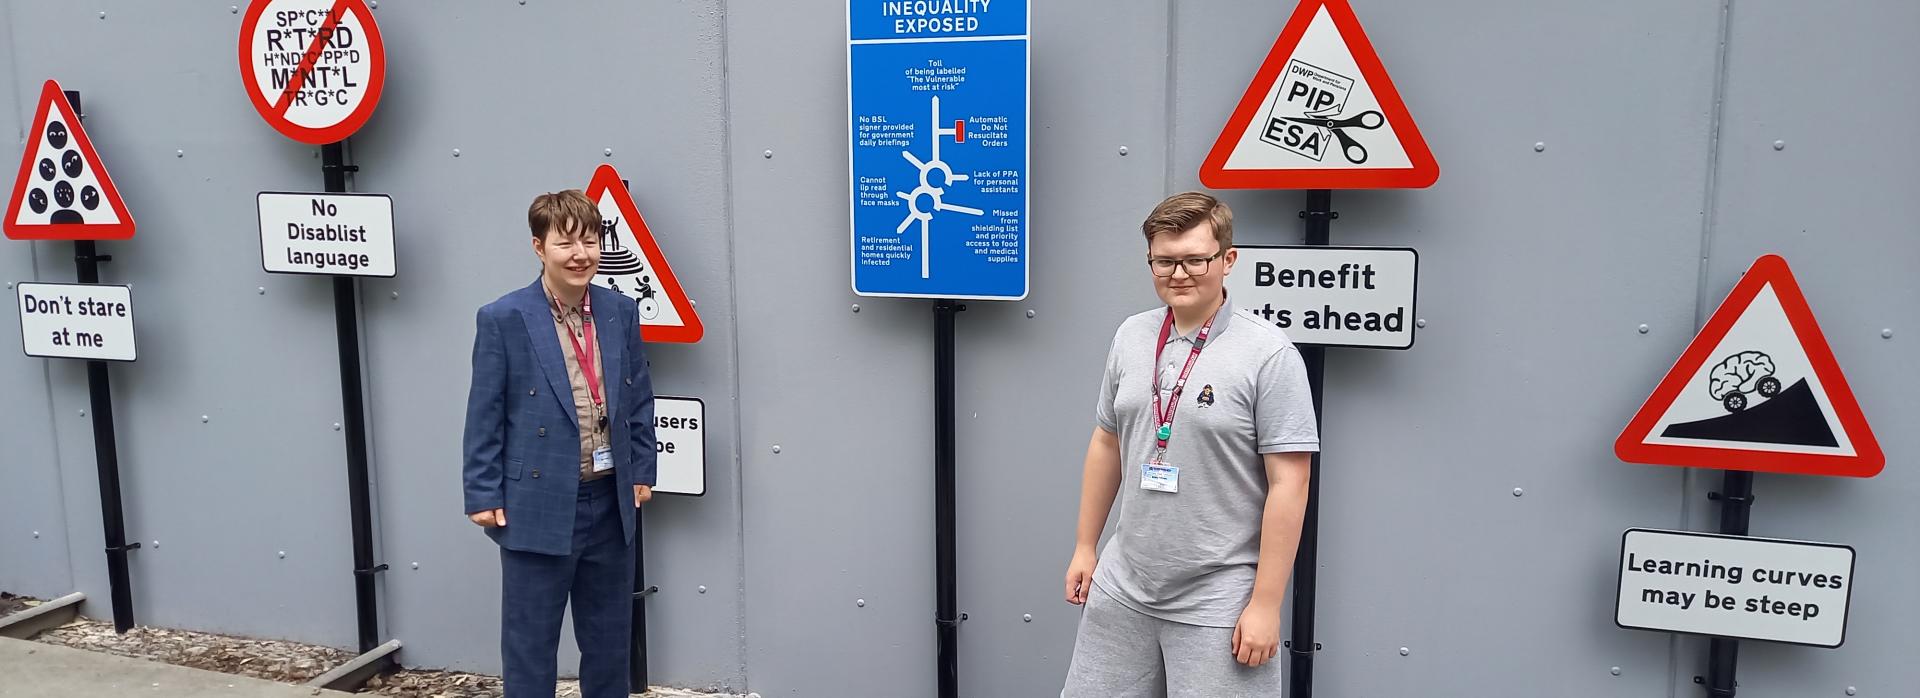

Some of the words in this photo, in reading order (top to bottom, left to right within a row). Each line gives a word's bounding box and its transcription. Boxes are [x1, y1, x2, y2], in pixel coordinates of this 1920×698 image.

[883, 0, 990, 16] INEQUALITY
[895, 17, 979, 34] EXPOSED
[928, 59, 942, 67] Toll
[914, 68, 935, 76] being
[936, 67, 966, 75] labelled
[1292, 65, 1314, 77] DWP
[925, 75, 965, 83] Vulnerable
[1287, 81, 1335, 111] PIP
[859, 123, 881, 131] signer
[882, 123, 914, 131] provided
[871, 131, 914, 139] government
[1265, 117, 1320, 156] ESA
[859, 139, 877, 147] daily
[878, 139, 910, 147] briefings
[973, 170, 991, 178] Lack
[992, 170, 1000, 178] of
[1002, 170, 1019, 178] PPA
[860, 176, 886, 184] Cannot
[973, 178, 984, 186] for
[986, 178, 1019, 187] personal
[860, 184, 869, 192] lip
[860, 192, 889, 200] through
[312, 199, 338, 217] No
[992, 209, 1019, 217] Missed
[287, 222, 367, 242] Disablist
[971, 224, 1005, 232] shielding
[861, 236, 901, 244] Retirement
[975, 232, 990, 240] and
[990, 232, 1019, 241] priority
[876, 244, 913, 252] residential
[989, 247, 1019, 255] medical
[287, 247, 370, 270] language
[861, 251, 884, 259] homes
[885, 251, 911, 260] quickly
[987, 255, 1019, 264] supplies
[1255, 261, 1376, 290] Benefit
[24, 294, 73, 315] Don't
[78, 297, 126, 318] stare
[1303, 304, 1404, 333] ahead
[52, 327, 71, 346] at
[76, 332, 104, 348] me
[1628, 552, 1743, 585] Learning
[1752, 567, 1843, 590] curves
[1641, 588, 1696, 610] may
[1704, 589, 1736, 611] be
[1744, 594, 1820, 621] steep
